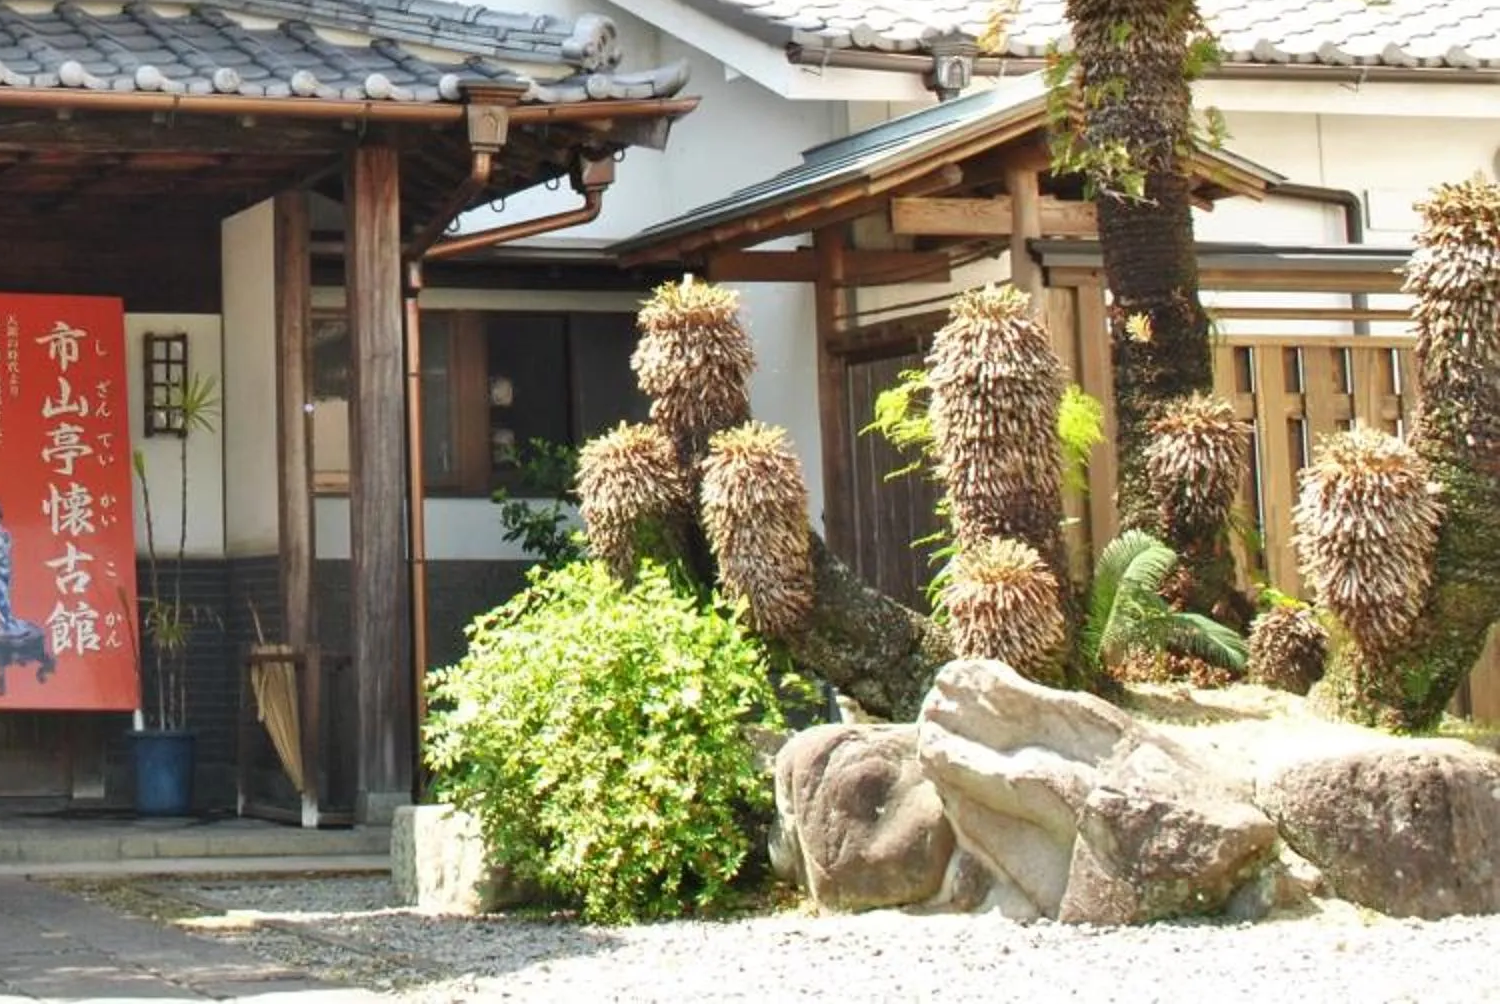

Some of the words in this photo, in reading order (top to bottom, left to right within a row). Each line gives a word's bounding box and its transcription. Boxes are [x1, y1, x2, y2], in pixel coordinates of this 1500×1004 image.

[35, 320, 101, 656] 市山亭懐古館
